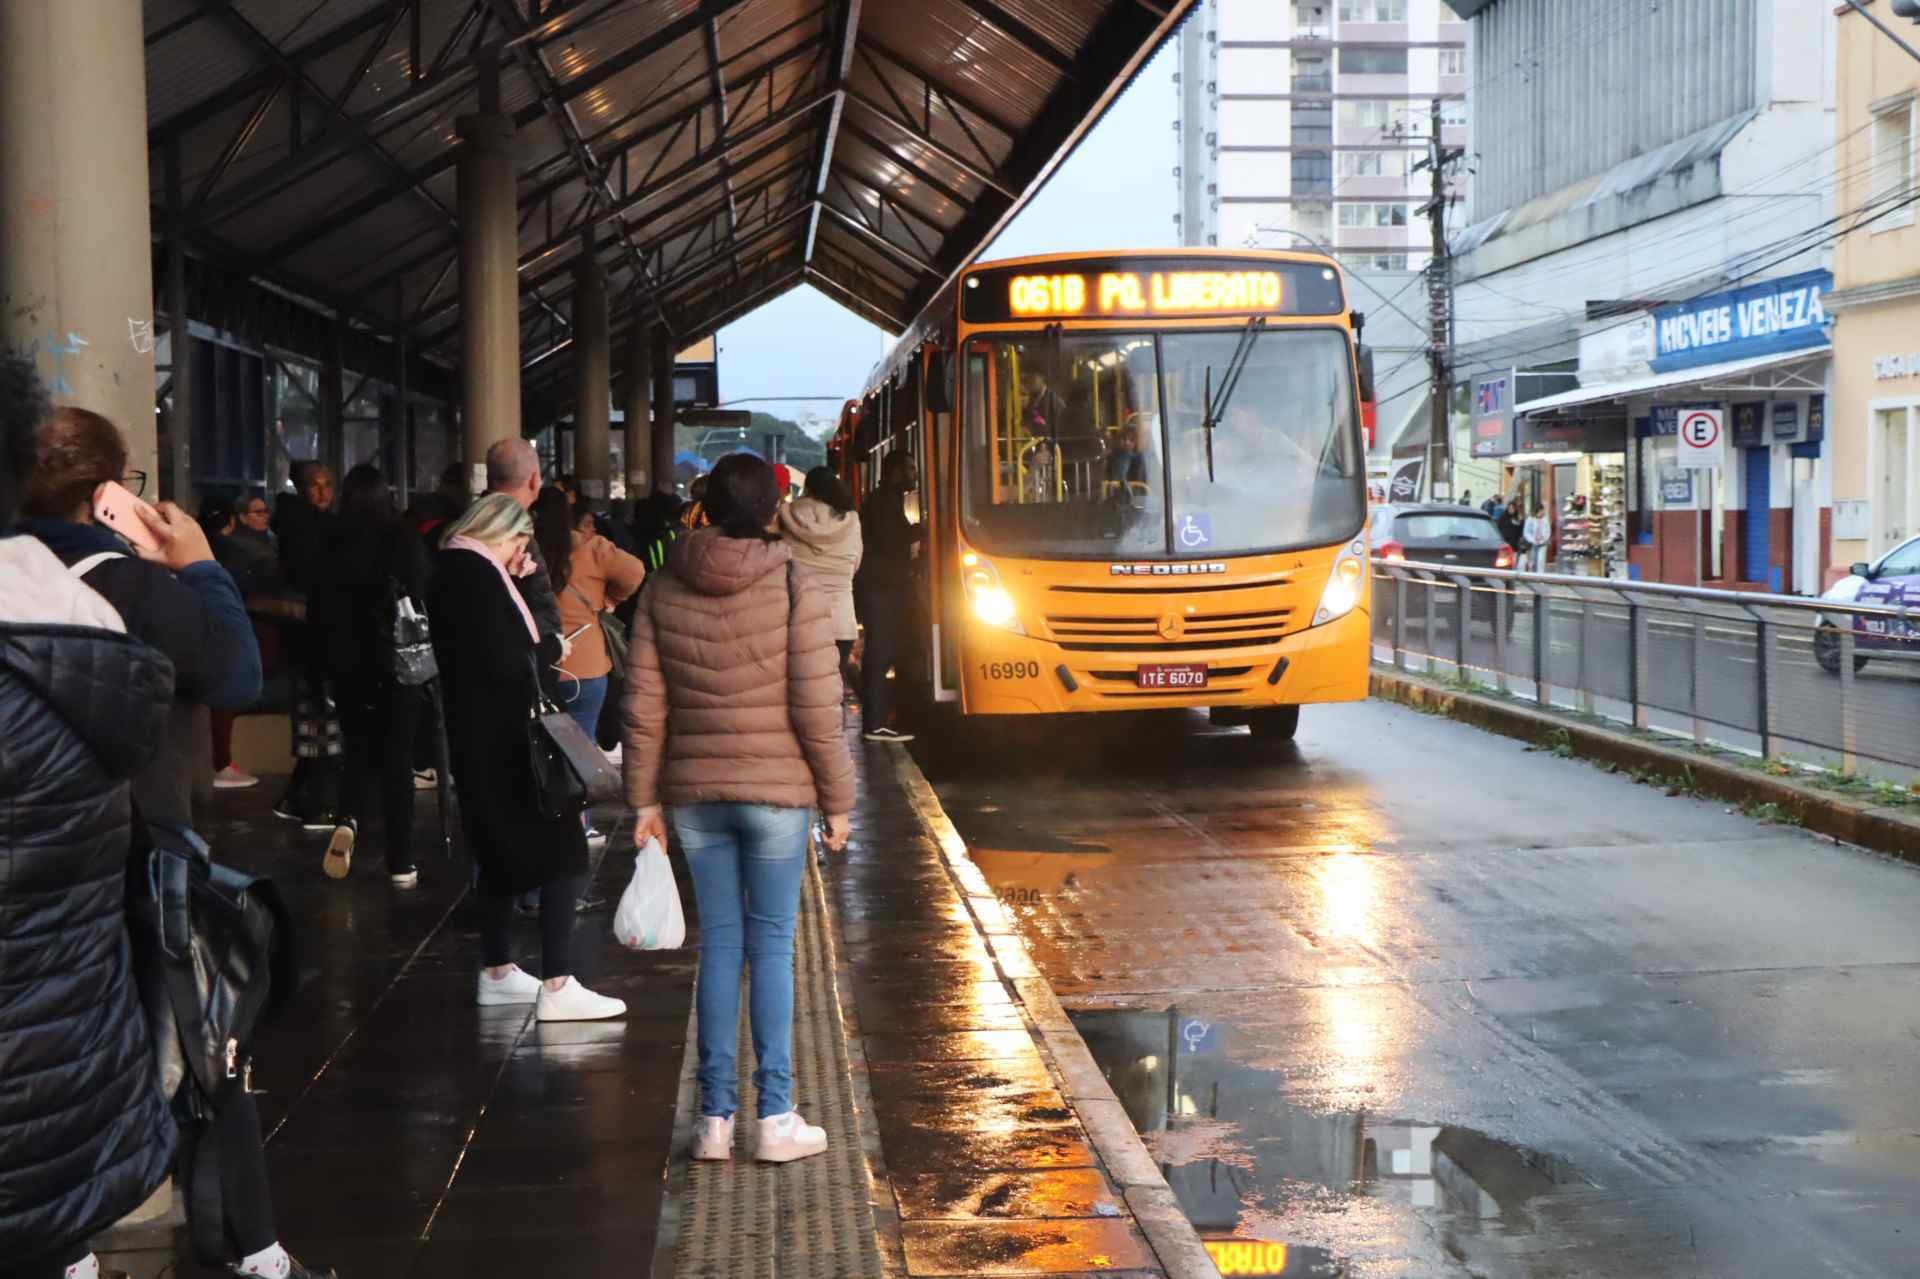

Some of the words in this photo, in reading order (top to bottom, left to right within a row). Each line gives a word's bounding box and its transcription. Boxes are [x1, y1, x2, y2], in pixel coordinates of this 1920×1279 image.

[1151, 271, 1281, 310] LIBERATO
[1737, 286, 1824, 338] VENEZA
[1694, 420, 1707, 441] E
[980, 660, 1039, 681] 16990
[1143, 673, 1166, 685] ITE
[1169, 672, 1204, 684] 6070
